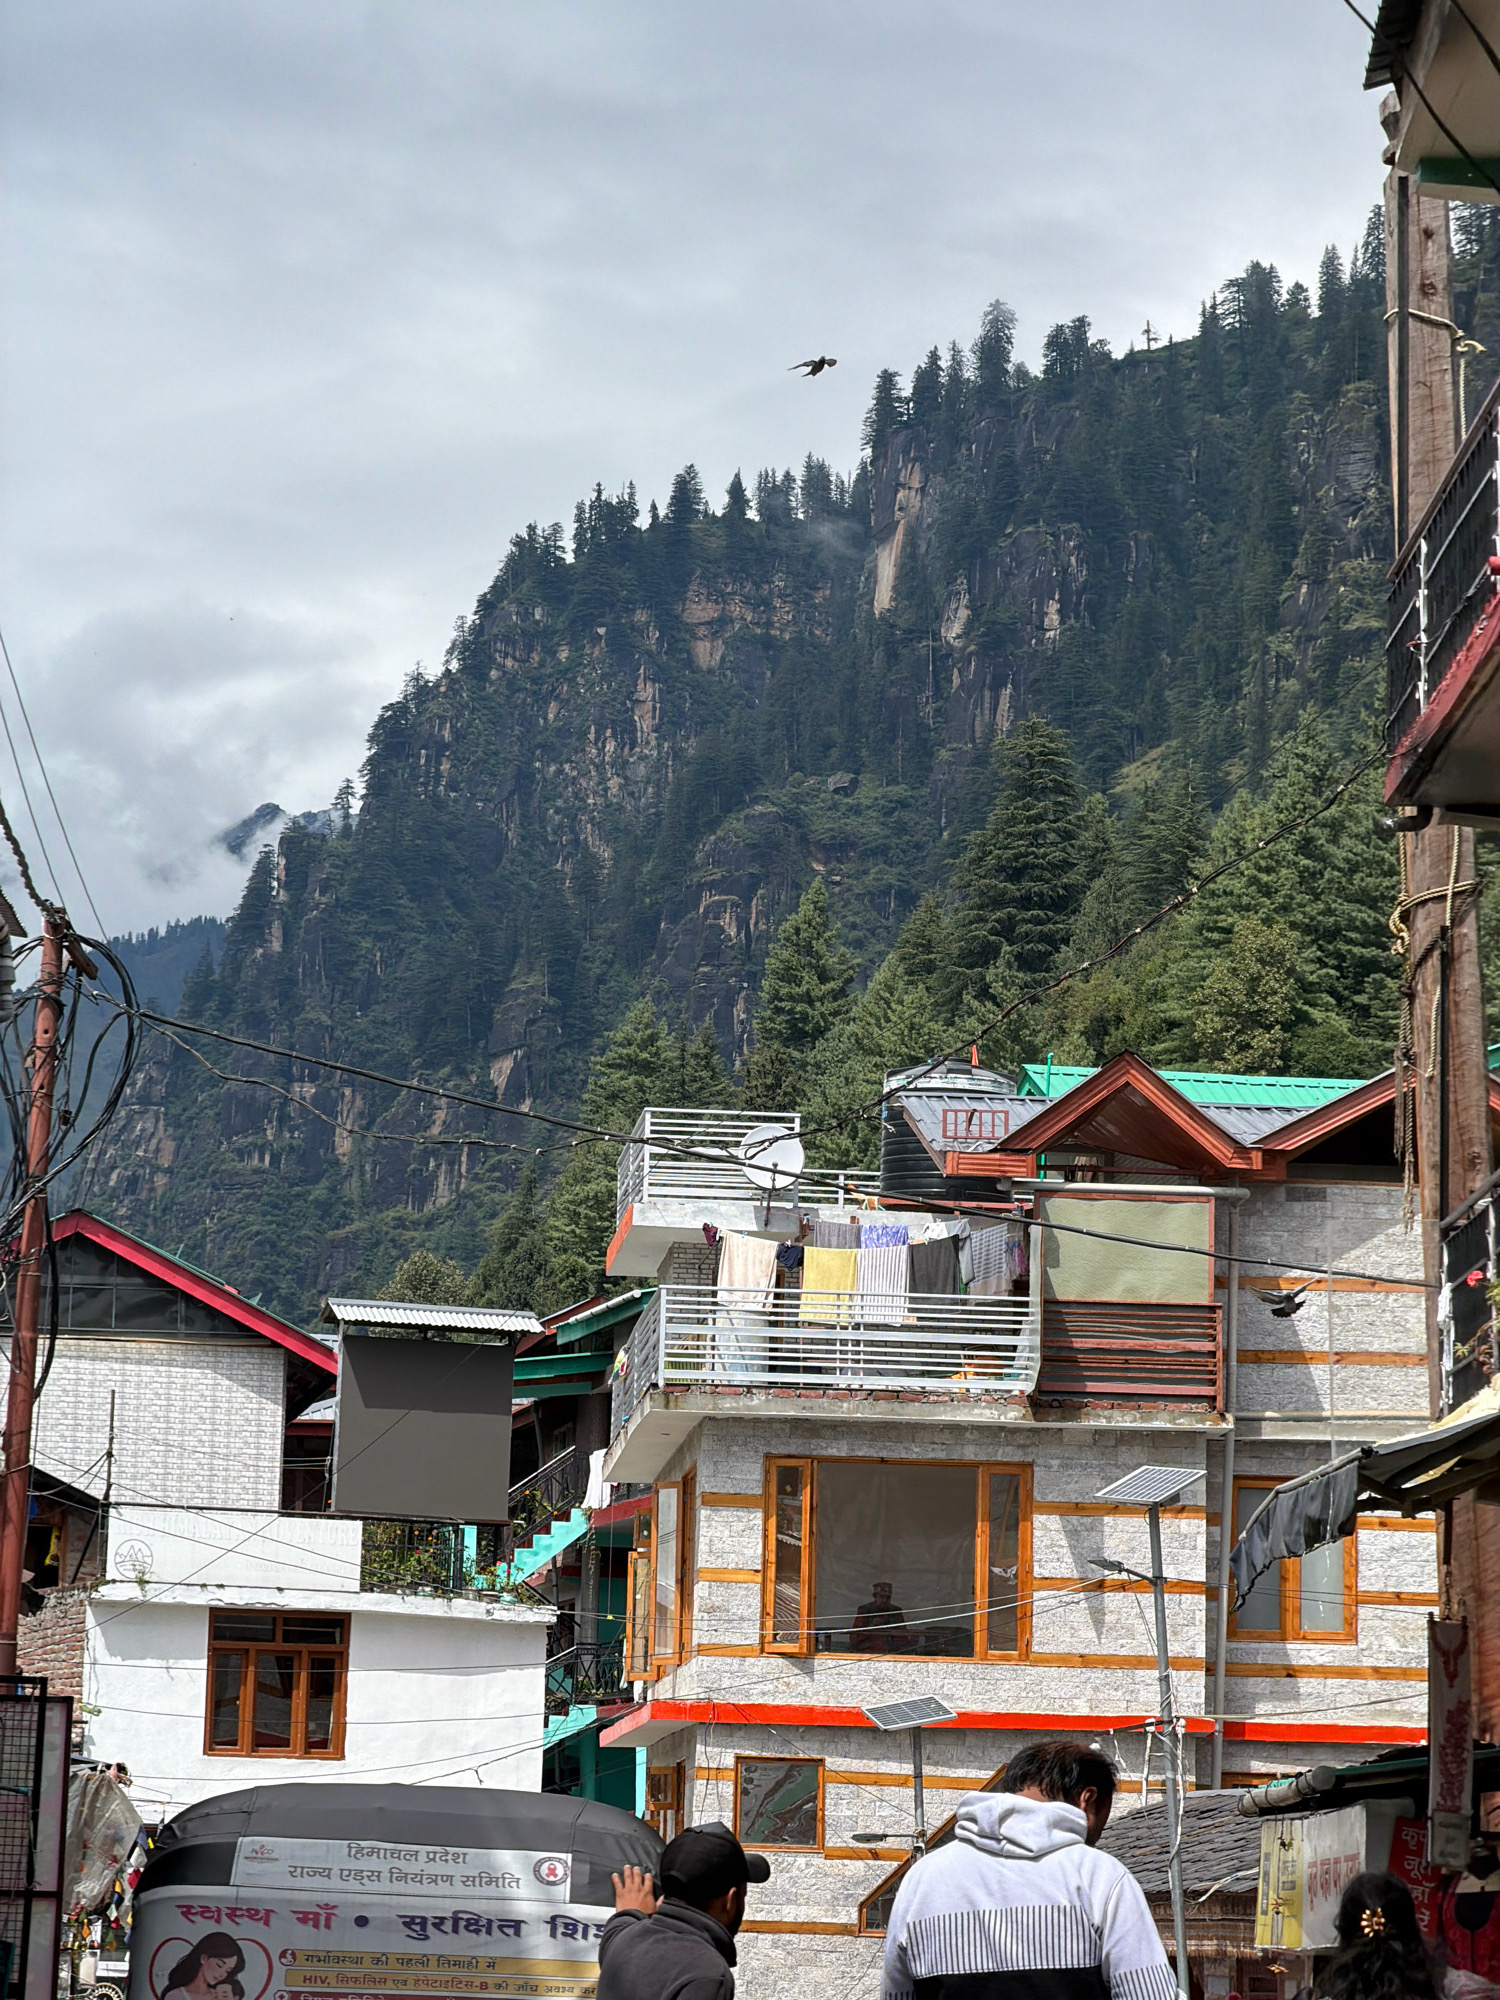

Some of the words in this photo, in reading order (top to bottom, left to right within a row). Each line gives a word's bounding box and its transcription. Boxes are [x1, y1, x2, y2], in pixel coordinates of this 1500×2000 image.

[346, 1842, 419, 1863] हिमाचल
[424, 1847, 468, 1865] प्रदेश
[288, 1864, 333, 1880] राज्य
[339, 1867, 382, 1887] एड्स
[388, 1868, 454, 1887] नियंत्रण
[461, 1872, 521, 1889] समिति
[175, 1904, 278, 1928] स्वस्थ
[290, 1903, 339, 1931] माँ
[396, 1909, 530, 1941] सुरक्षित
[304, 1951, 364, 1966] गर्भावस्था
[370, 1951, 389, 1967] की
[395, 1955, 430, 1968] पहली
[437, 1956, 479, 1970] तिमाही
[485, 1958, 499, 1970] में
[303, 1974, 330, 1986] HIV,
[335, 1973, 388, 1986] सिफलिस
[392, 1977, 408, 1989] एवं
[413, 1976, 489, 1990] हेपेटाइटिस-B
[494, 1980, 508, 1991] की
[513, 1980, 539, 1993] जाँच
[579, 1986, 597, 1996] कर
